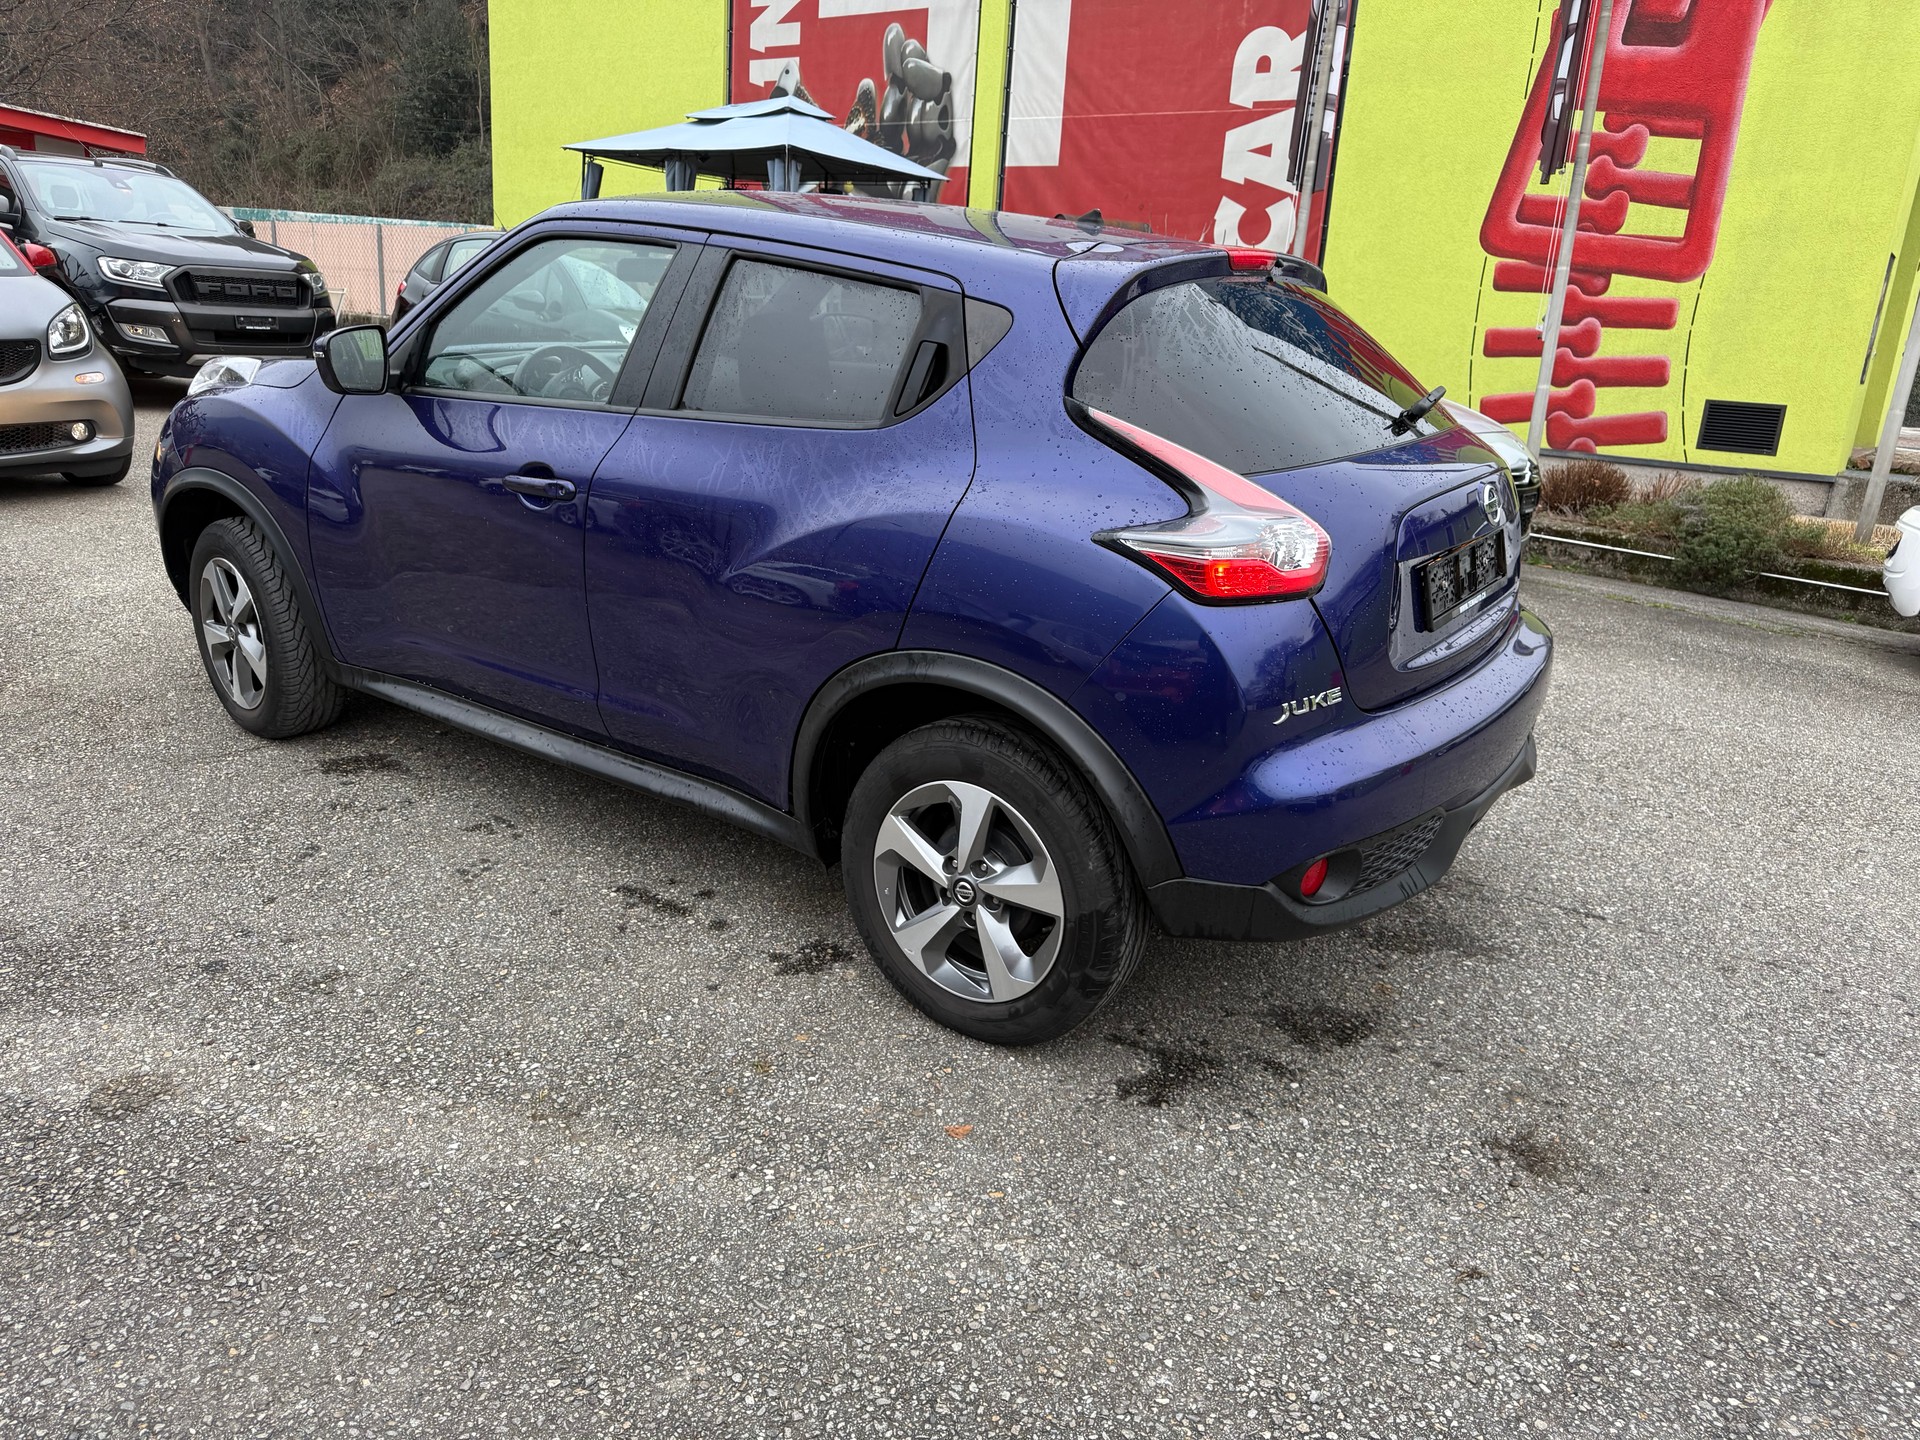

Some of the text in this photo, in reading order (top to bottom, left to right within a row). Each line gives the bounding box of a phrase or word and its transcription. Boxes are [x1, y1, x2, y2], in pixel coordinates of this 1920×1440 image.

[1213, 26, 1308, 253] CAR
[195, 282, 297, 298] FORD
[1272, 687, 1342, 725] JUKE
